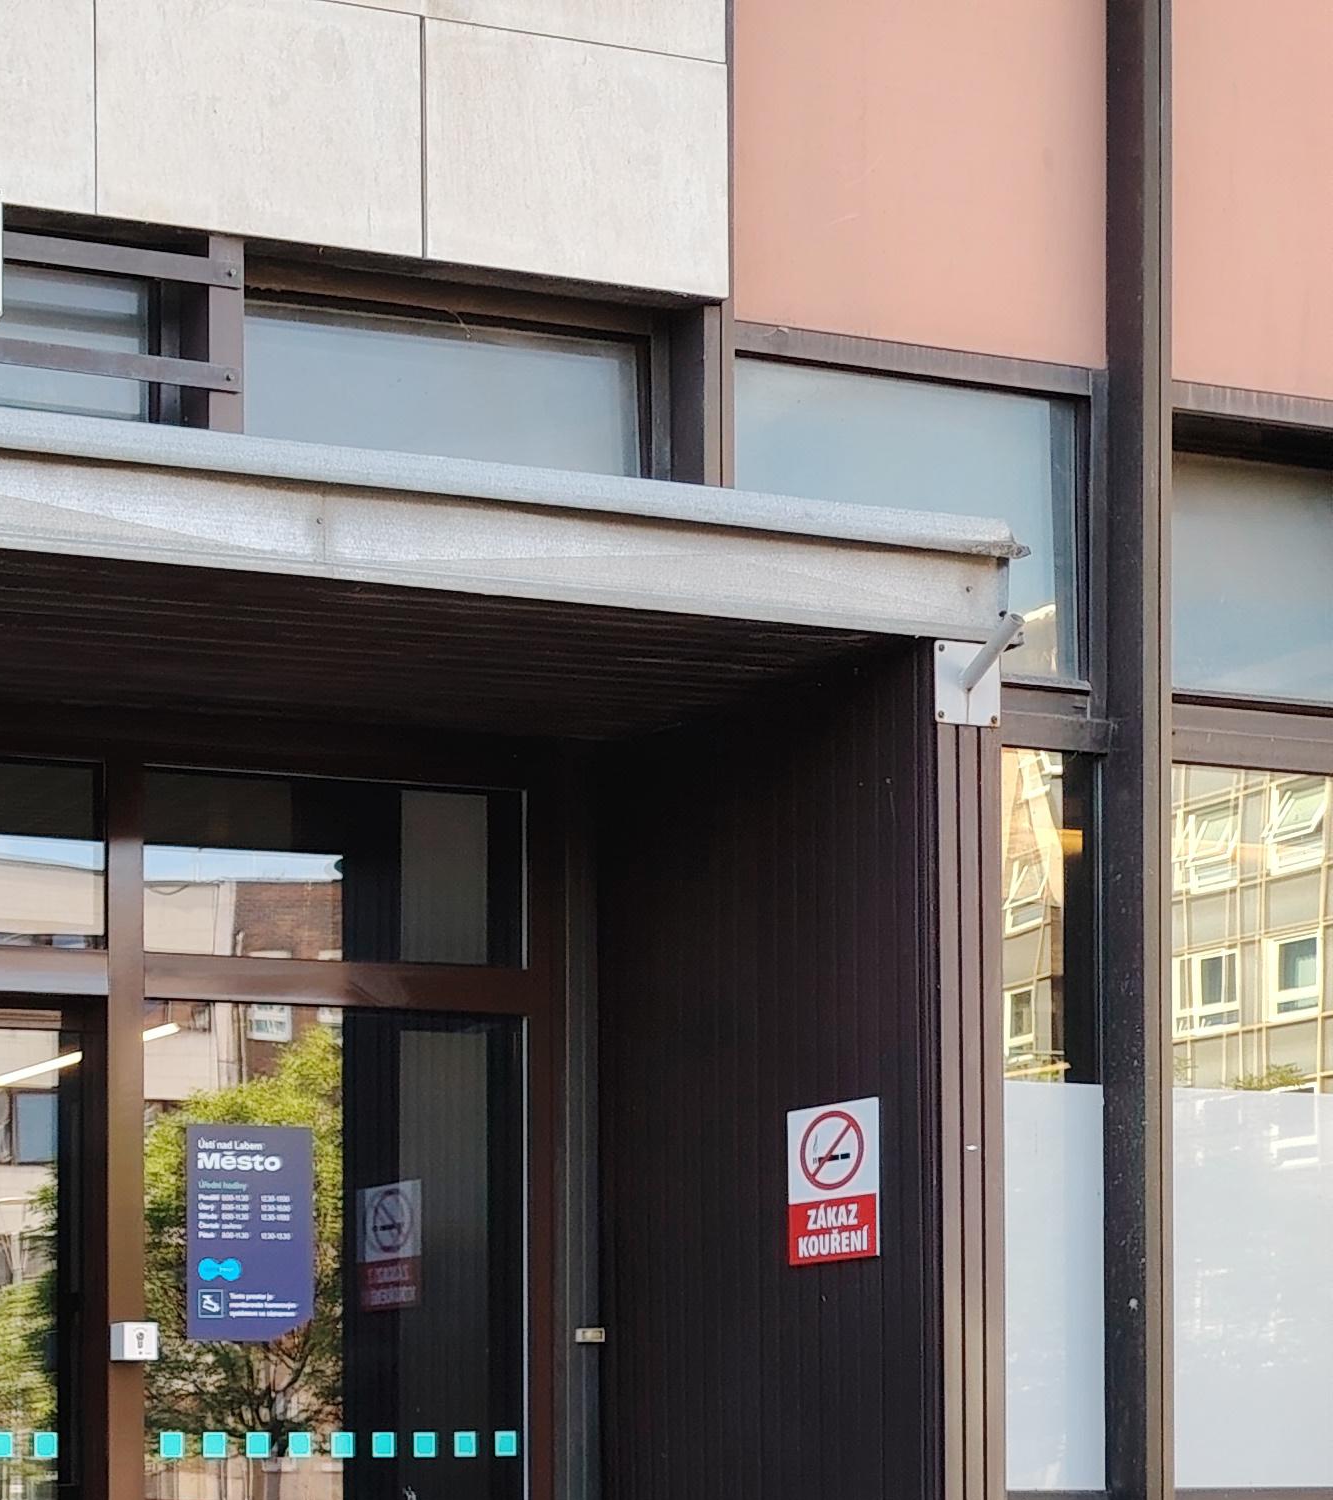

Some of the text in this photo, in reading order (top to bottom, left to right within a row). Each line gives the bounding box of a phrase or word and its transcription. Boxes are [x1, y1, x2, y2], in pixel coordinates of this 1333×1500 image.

[217, 1139, 232, 1149] nad
[234, 1139, 263, 1150] Labem
[197, 1151, 281, 1171] Město
[807, 1203, 858, 1230] ZÁKAZ
[798, 1225, 869, 1258] KOUŘENÍ
